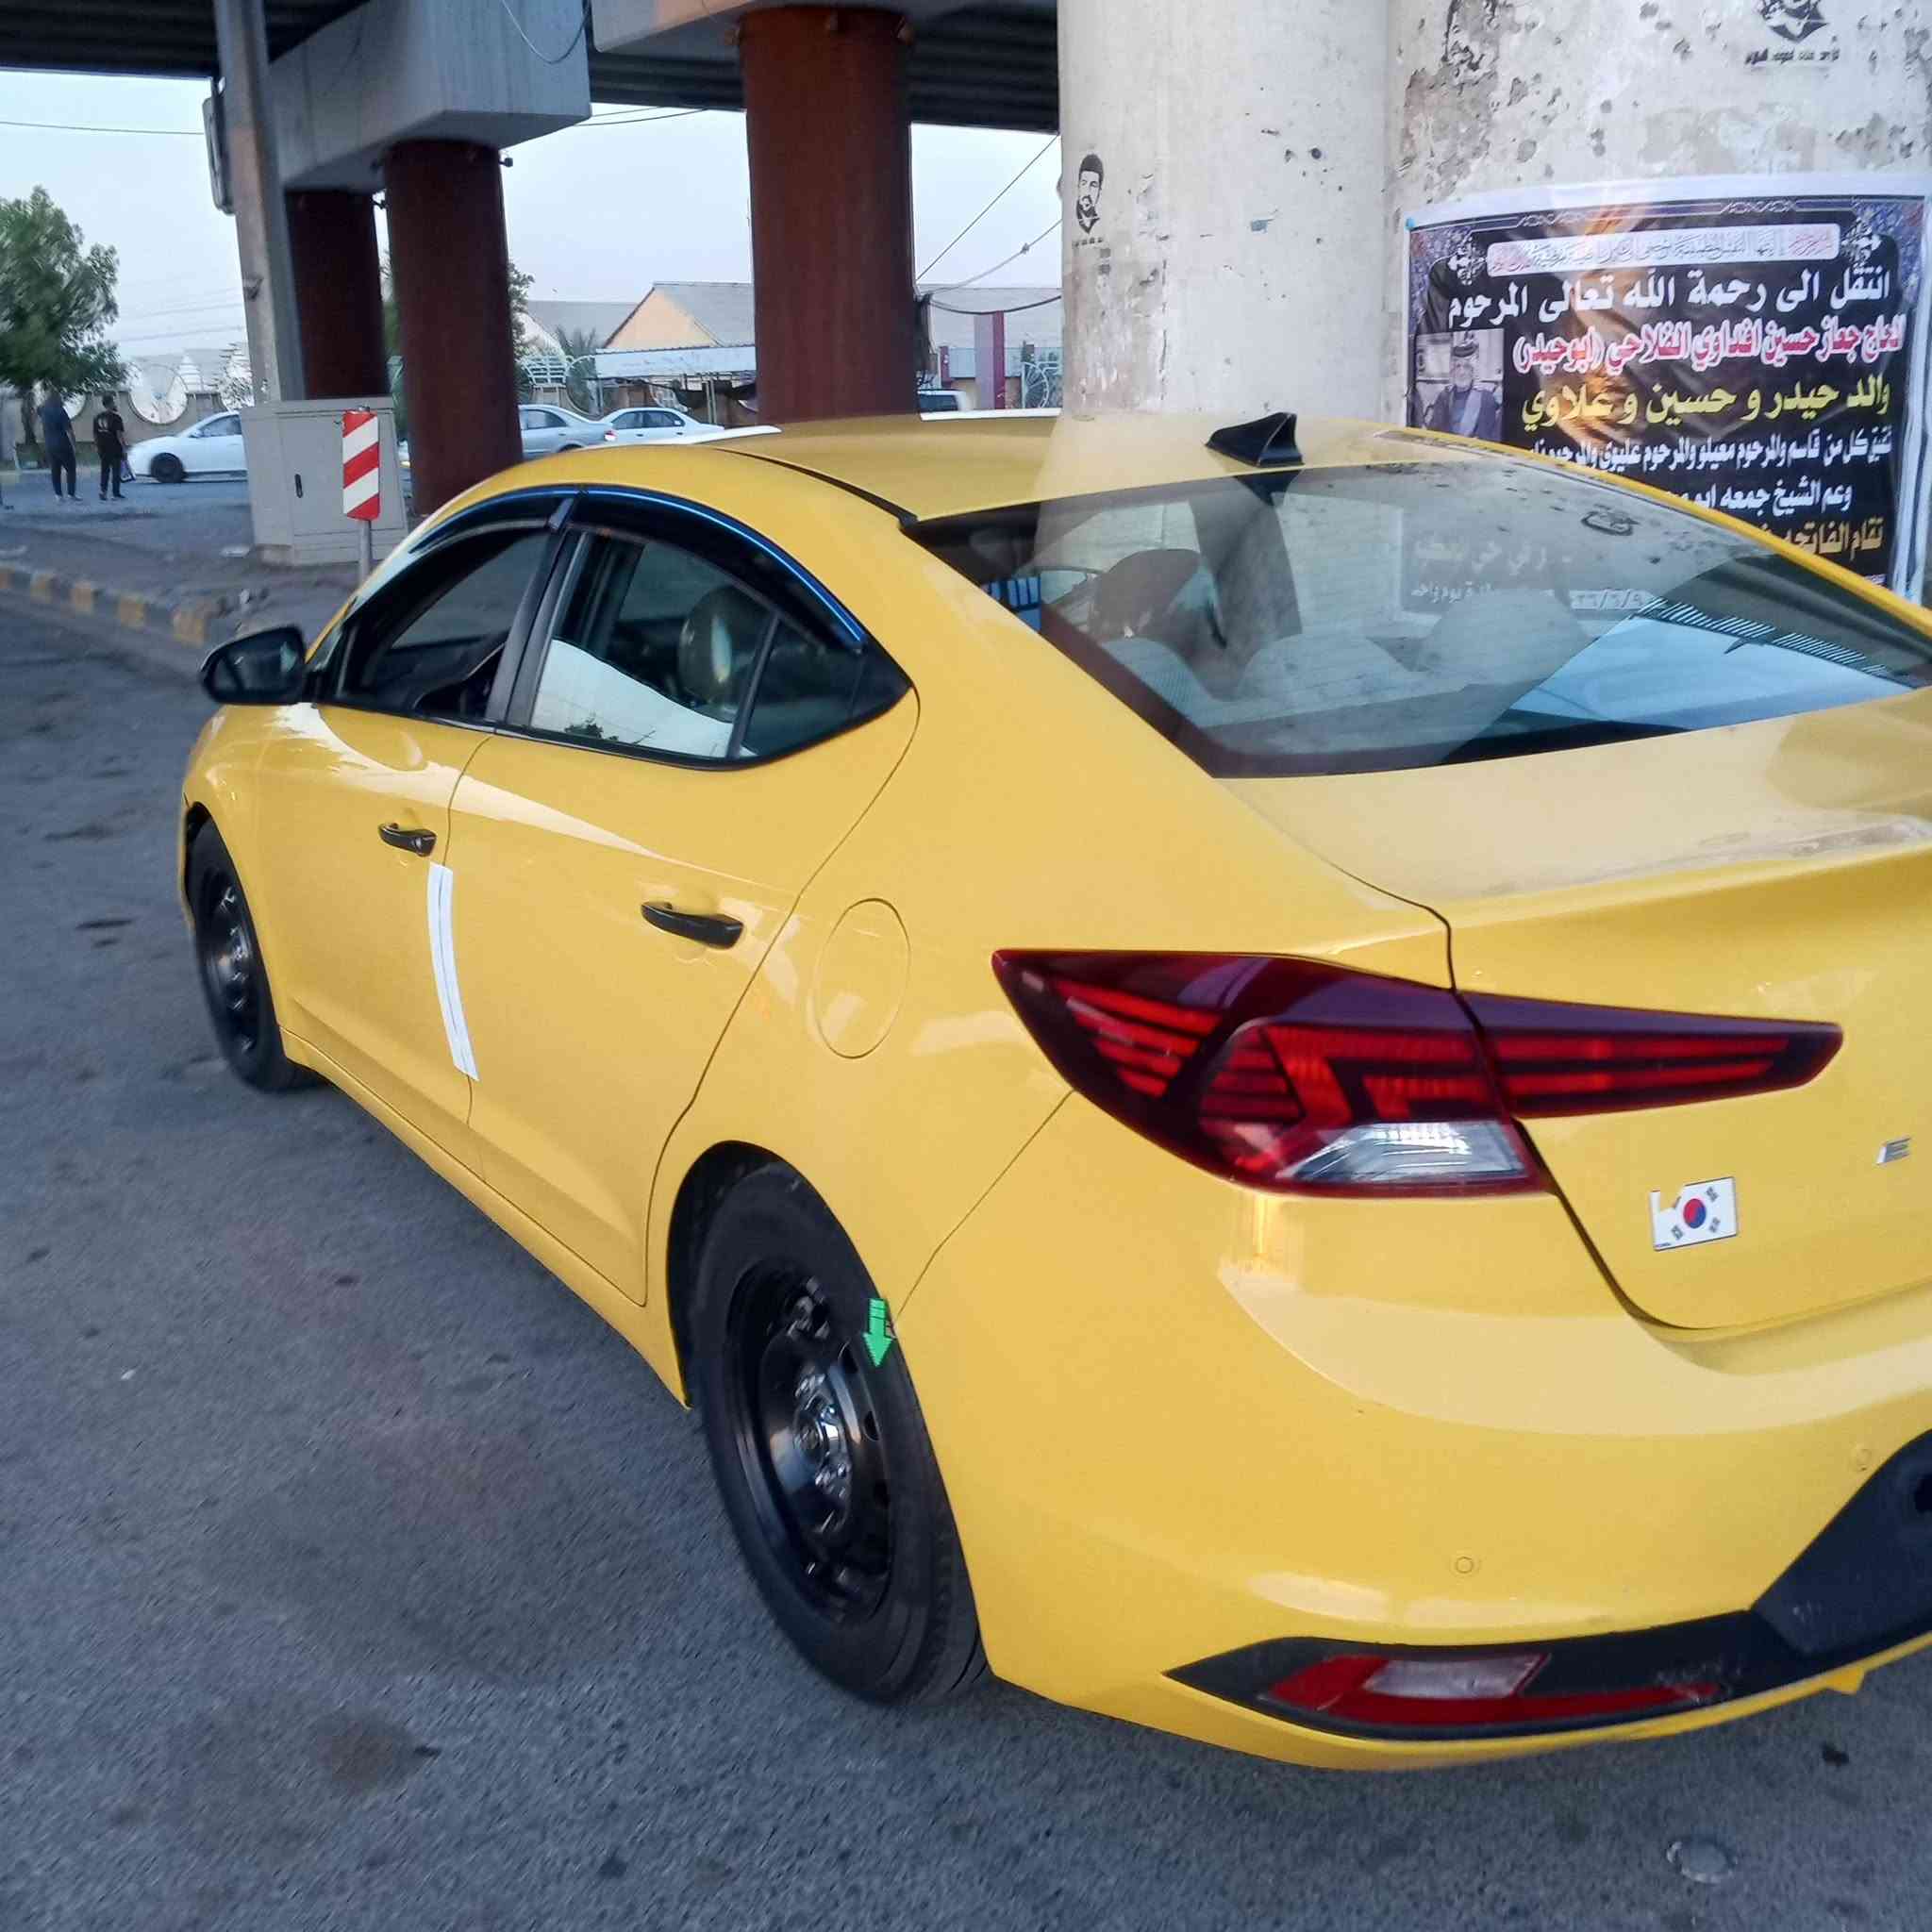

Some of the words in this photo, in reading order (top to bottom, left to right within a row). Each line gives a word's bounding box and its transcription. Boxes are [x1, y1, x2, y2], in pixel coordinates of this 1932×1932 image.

[1448, 282, 1527, 328] المرحوم
[1539, 275, 1614, 323] تعالى
[1623, 268, 1674, 308] الله
[1688, 270, 1767, 312] رحمة
[1775, 268, 1820, 312] الى
[1830, 262, 1890, 309] انتقل
[1760, 320, 1820, 367] حسين
[1522, 383, 1614, 431] علاوي
[1617, 392, 1638, 424] و
[1646, 383, 1737, 425] حسين
[1740, 389, 1761, 421] و
[1764, 381, 1840, 420] حيدر
[1847, 373, 1890, 414] والد
[1824, 434, 1842, 467] من
[1843, 428, 1868, 464] كل
[1772, 475, 1821, 516] الشيخ
